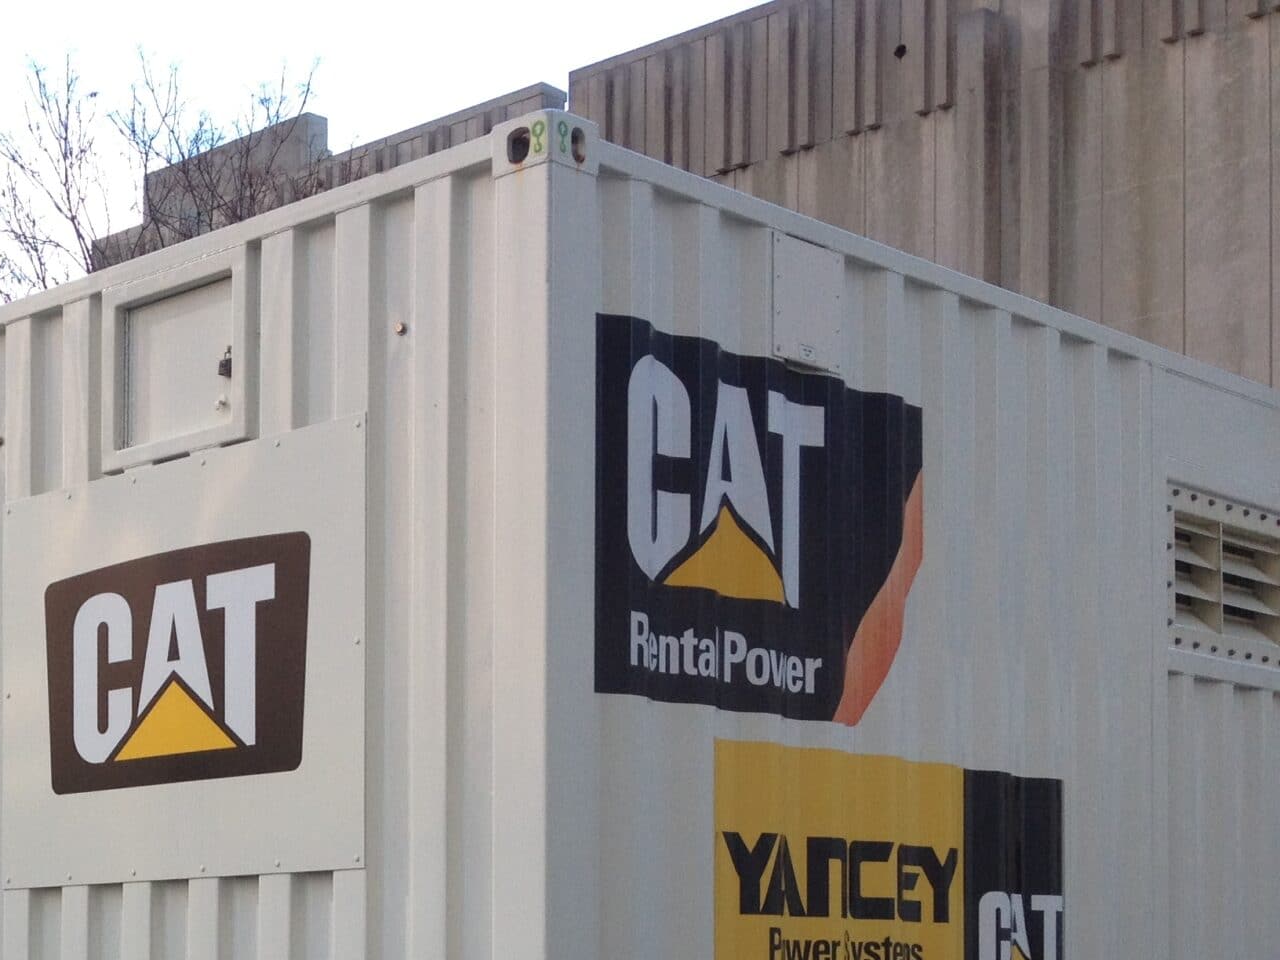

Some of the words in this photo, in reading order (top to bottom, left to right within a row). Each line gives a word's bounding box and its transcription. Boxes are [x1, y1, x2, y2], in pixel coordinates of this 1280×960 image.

[627, 354, 825, 609] CAT
[73, 562, 276, 764] CAT
[630, 610, 719, 680] Rental
[724, 630, 822, 694] Power
[722, 831, 959, 923] YANCEY
